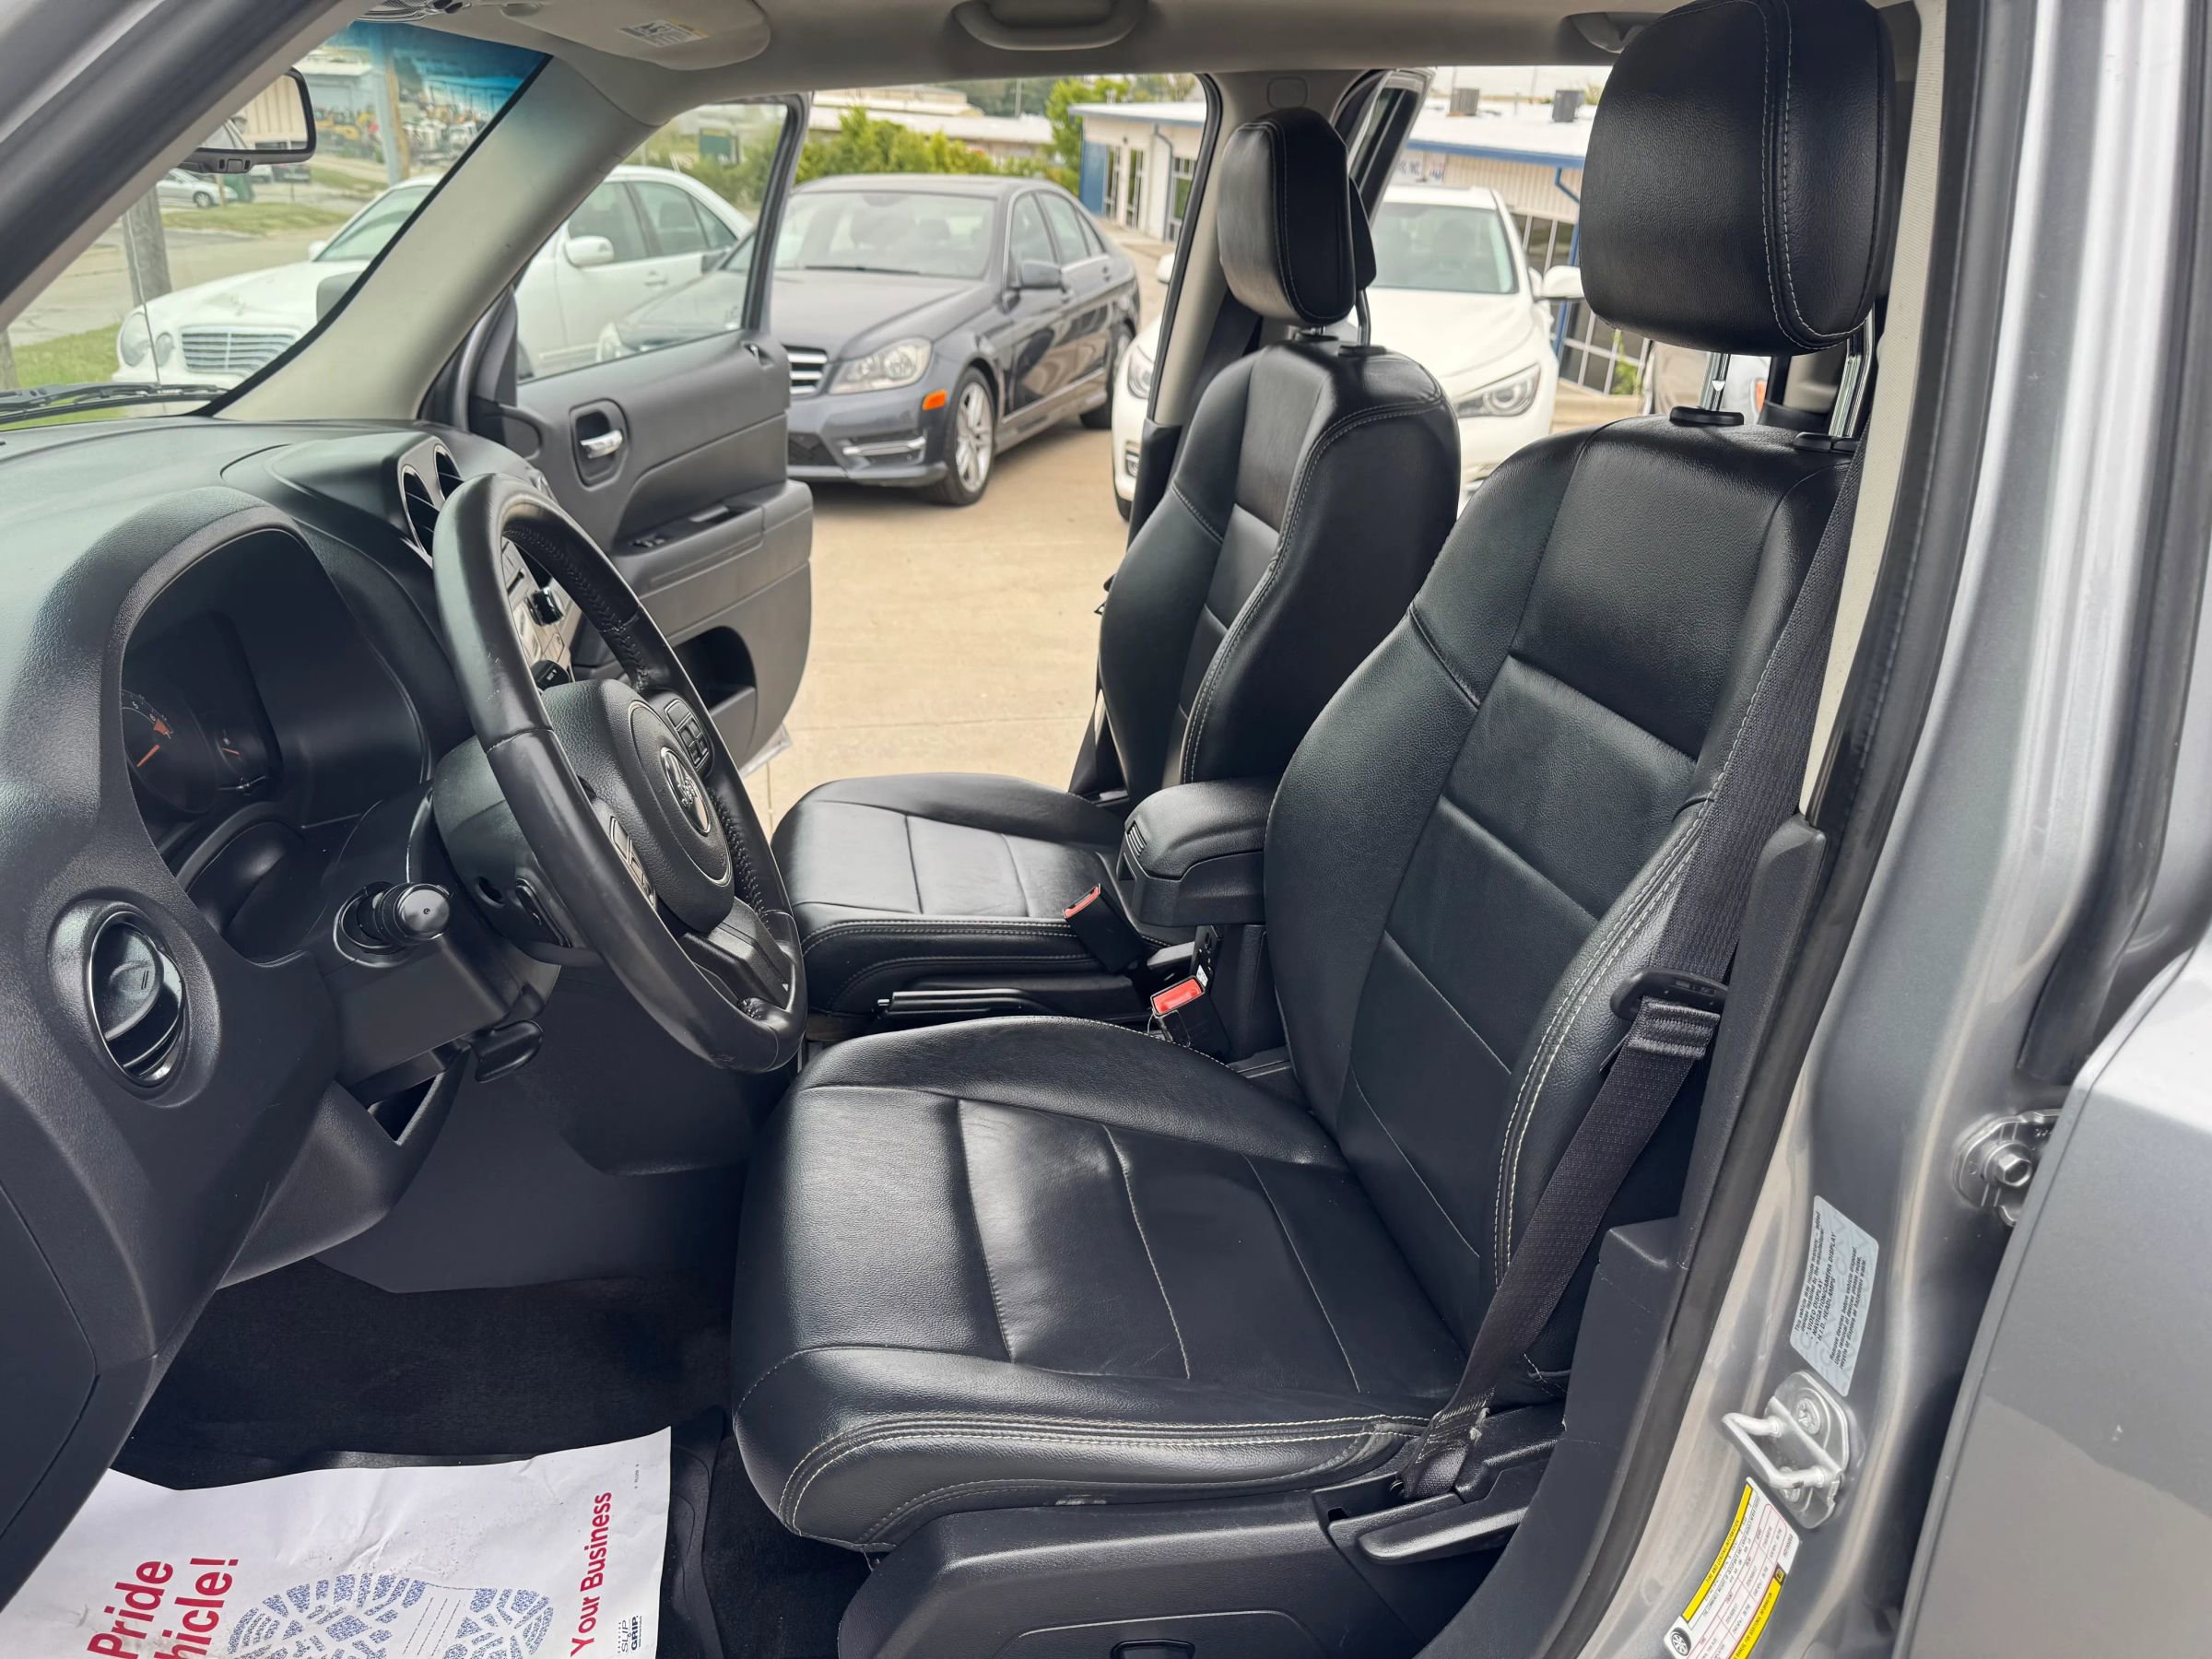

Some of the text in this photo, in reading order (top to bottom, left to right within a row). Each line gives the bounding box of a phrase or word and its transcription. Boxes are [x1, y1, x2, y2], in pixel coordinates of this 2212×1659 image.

[1798, 1296, 1806, 1320] vehicle
[1806, 1261, 1814, 1284] include
[1810, 1238, 1818, 1263] mercury
[1811, 1230, 1836, 1336] NAVIGATION/CAMERA DISPLAY
[1821, 1275, 1836, 1321] HEADLAMPS
[1841, 1293, 1849, 1314] before
[1844, 1271, 1853, 1295] vehicle
[1800, 1309, 1808, 1333] devices
[1806, 1277, 1823, 1332] VIDEO DISPLAY
[1833, 1347, 1841, 1366] Upon
[1838, 1324, 1847, 1349] removal
[1845, 1293, 1854, 1318] devices
[1850, 1273, 1858, 1295] please
[1835, 1312, 1844, 1337] devices
[1829, 1335, 1839, 1361] Remove
[1839, 1346, 1848, 1371] recycle
[1845, 1315, 1856, 1341] dispose
[570, 1491, 612, 1658] Your Business
[1710, 1561, 1719, 1574] AND
[87, 1560, 174, 1659] Pride
